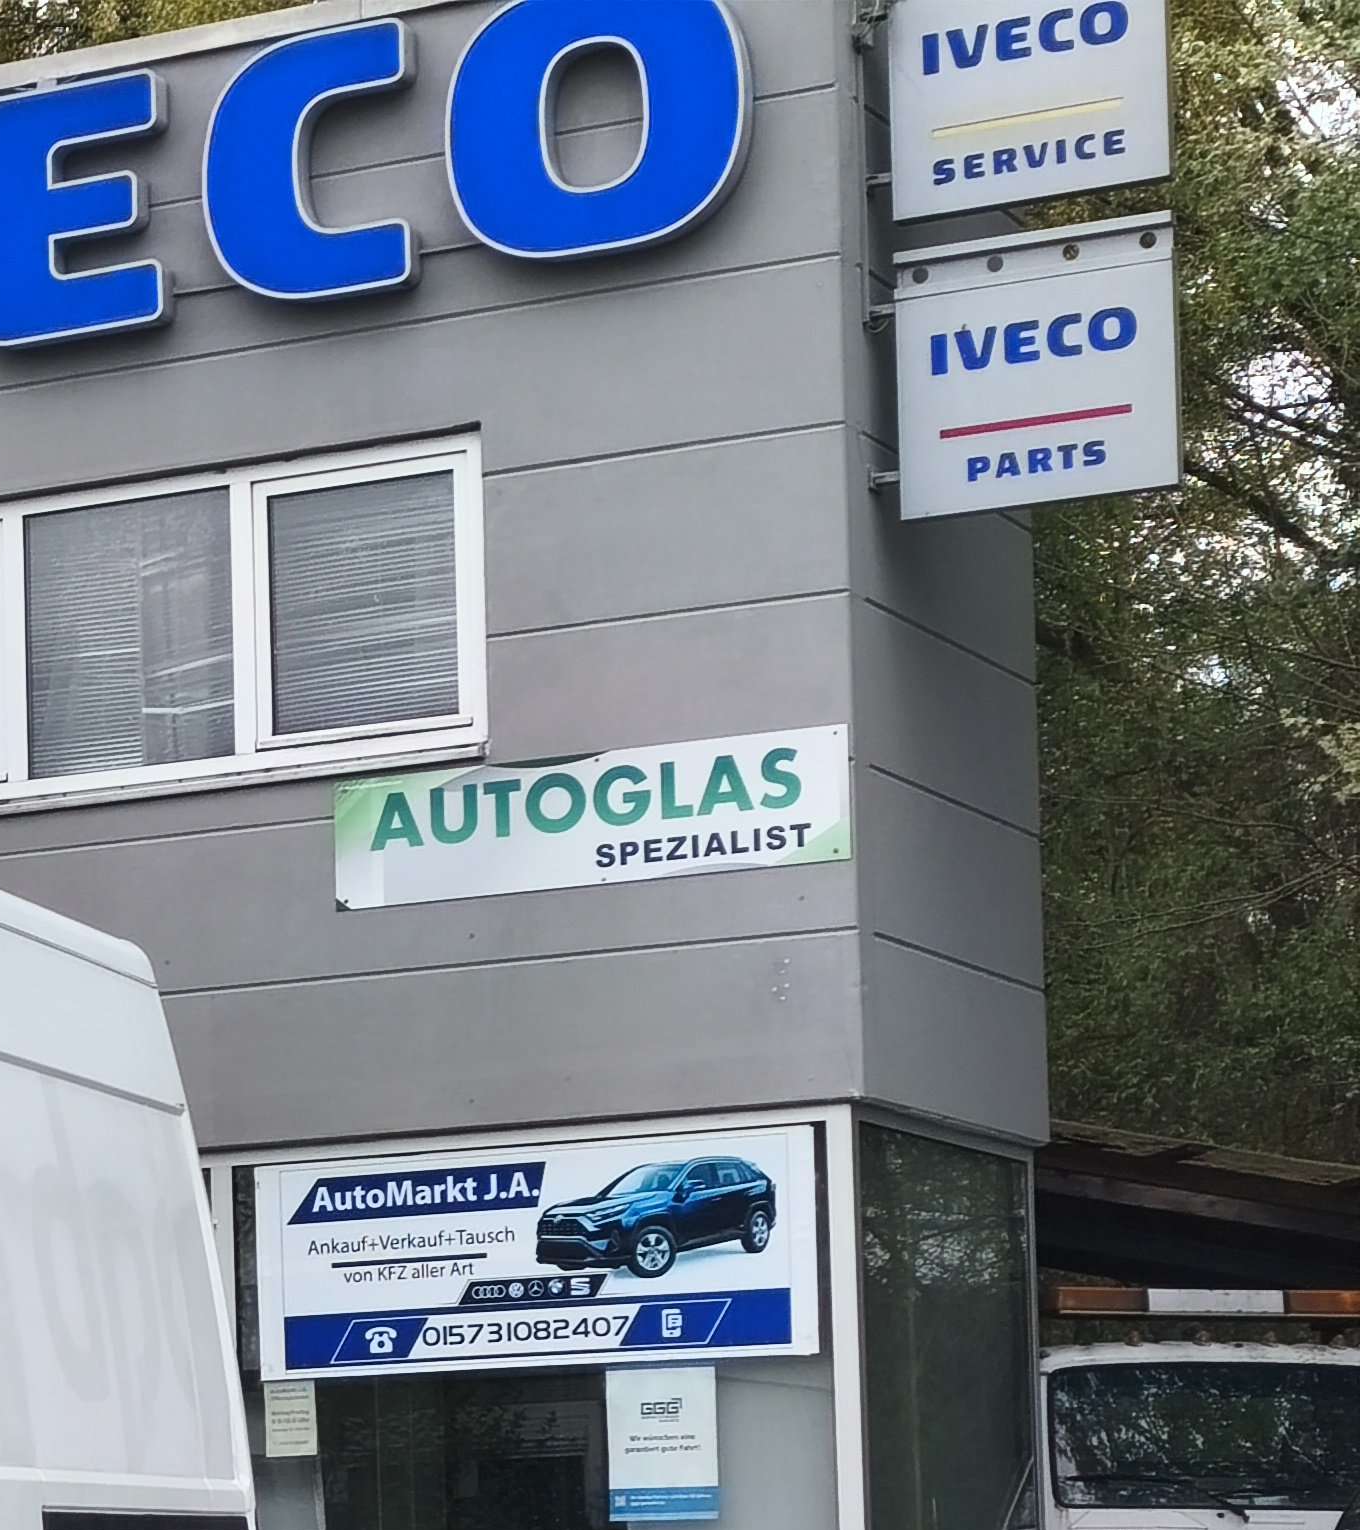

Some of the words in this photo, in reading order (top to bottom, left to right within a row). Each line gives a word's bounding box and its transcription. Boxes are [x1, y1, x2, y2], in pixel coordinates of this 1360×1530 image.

[922, 0, 1129, 75] IVECO
[932, 129, 1126, 186] SERVICE
[930, 307, 1137, 376] IVECO
[967, 440, 1107, 482] PARTS
[370, 747, 803, 851] AUTOGLAS
[595, 823, 812, 868] SPEZIALIST
[312, 1175, 478, 1213] AutoMarkt
[483, 1171, 540, 1201] J.A.
[307, 1226, 516, 1256] Ankauf+Verkauf+Tausch
[344, 1270, 373, 1283] von
[378, 1266, 408, 1281] KFZ
[411, 1264, 445, 1279] aller
[450, 1262, 475, 1277] Art
[422, 1315, 630, 1347] 015731082407
